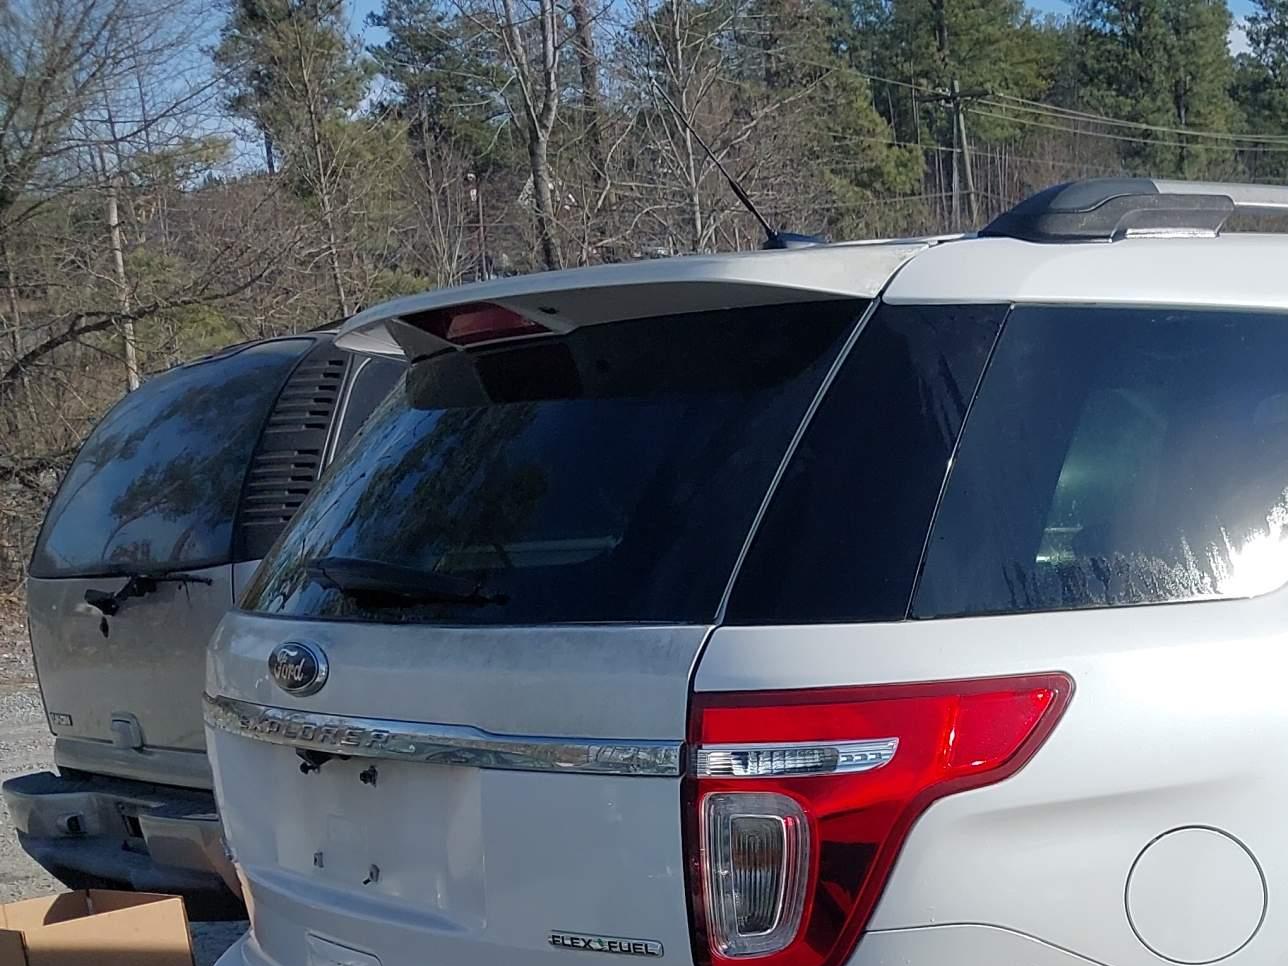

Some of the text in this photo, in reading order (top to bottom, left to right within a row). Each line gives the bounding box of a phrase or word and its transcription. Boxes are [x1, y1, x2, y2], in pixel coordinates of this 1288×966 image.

[273, 648, 306, 682] Ford
[239, 716, 391, 749] EXPLORER
[551, 934, 660, 957] FLEX FUEL
